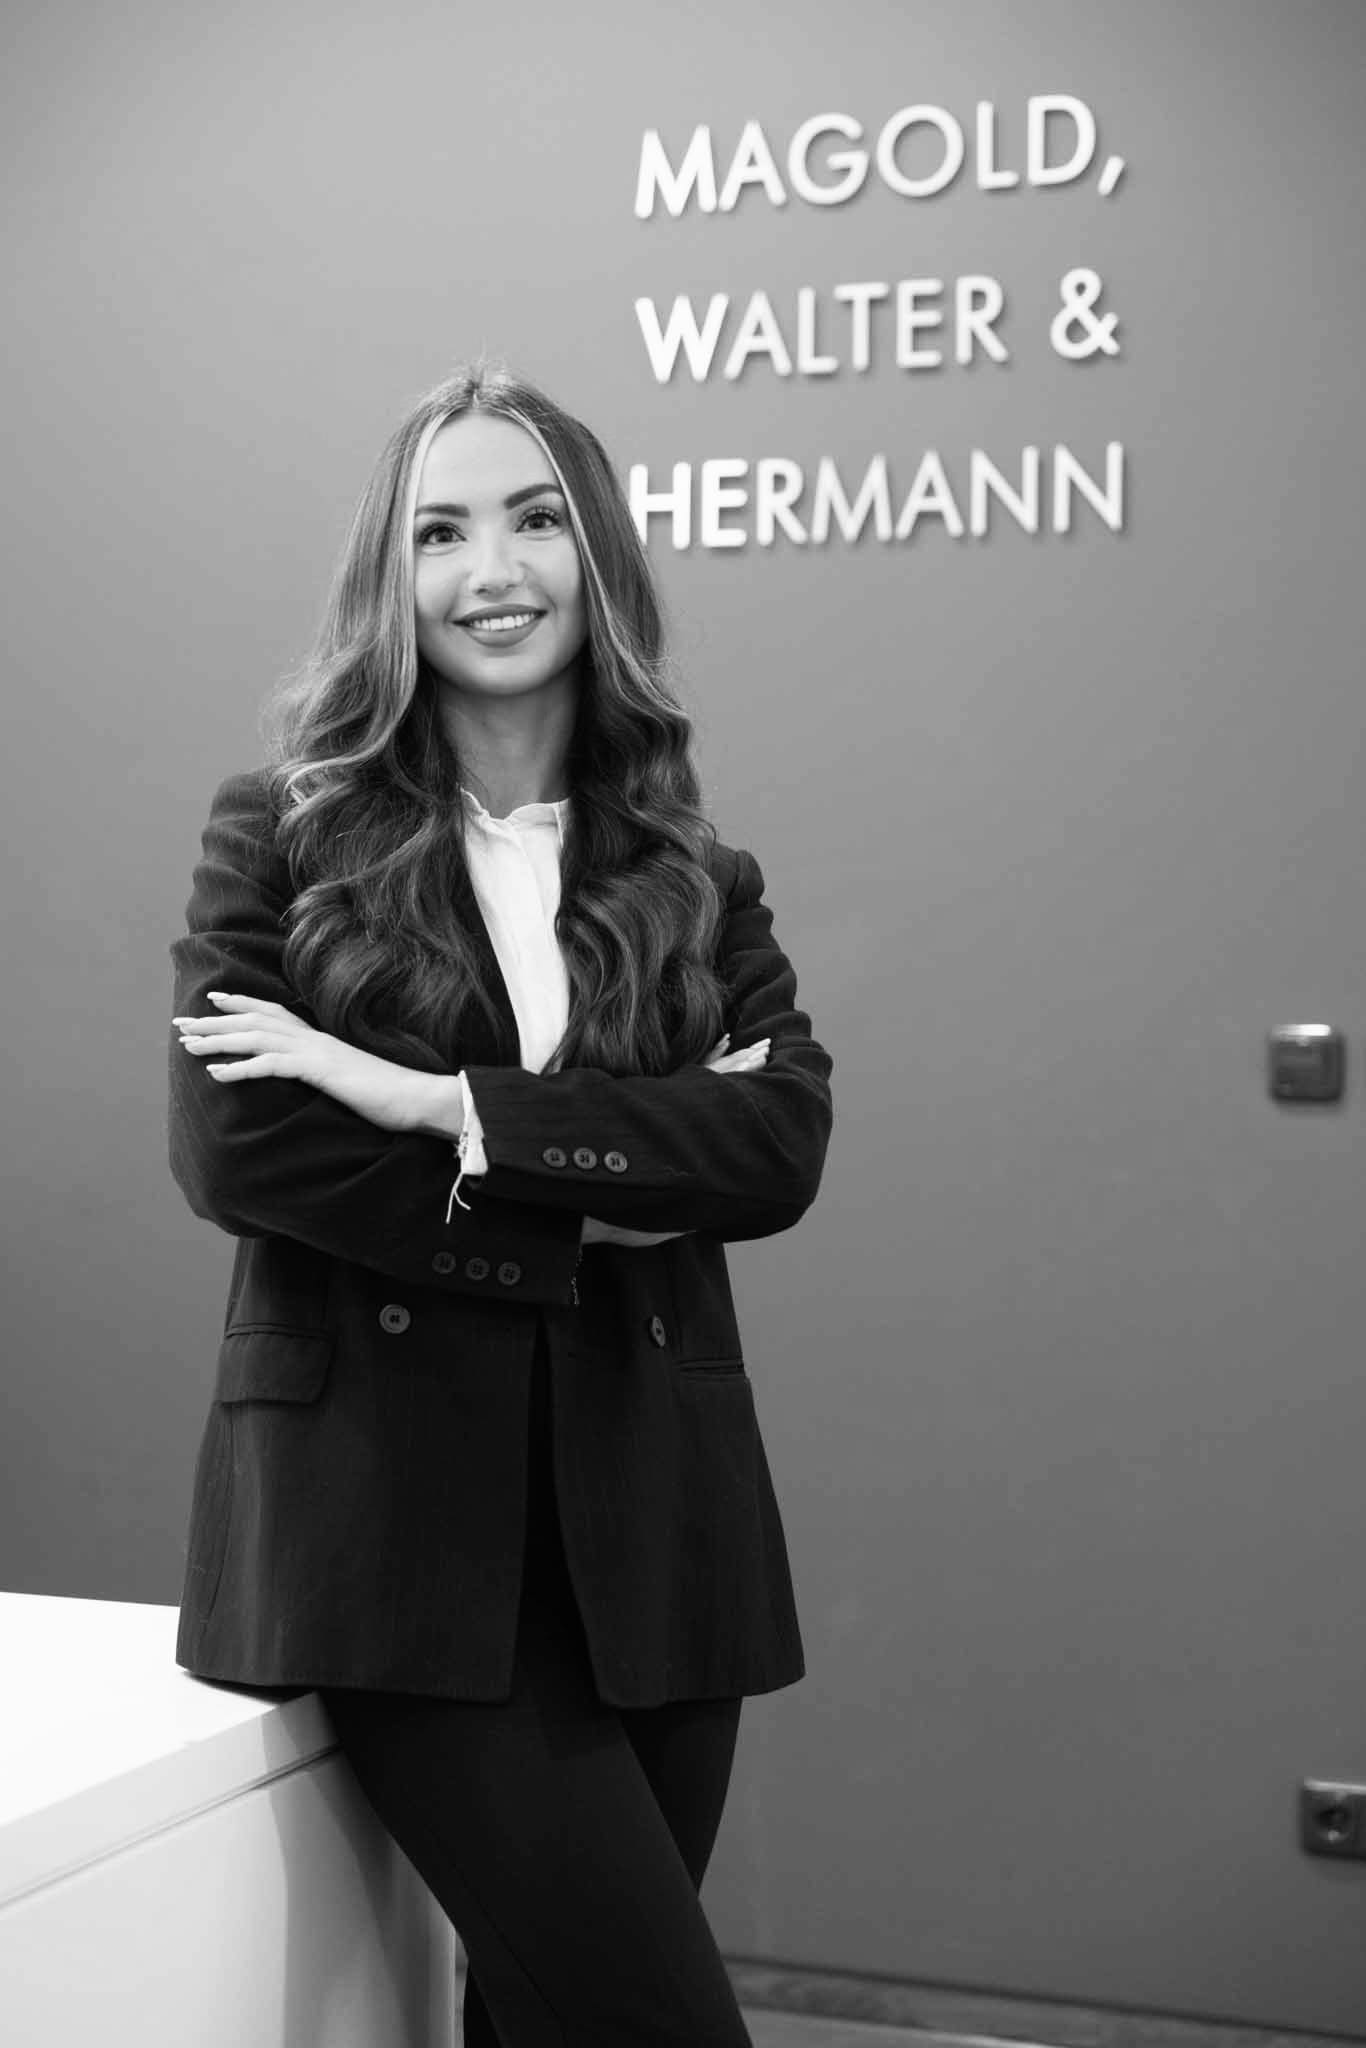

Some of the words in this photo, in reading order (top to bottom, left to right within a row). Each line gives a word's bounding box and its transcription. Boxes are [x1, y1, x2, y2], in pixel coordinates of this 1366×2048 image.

[633, 94, 1125, 219] MAGOLD,
[634, 275, 1008, 384] WALTER
[1050, 267, 1120, 359] &
[628, 441, 1124, 551] HERMANN
